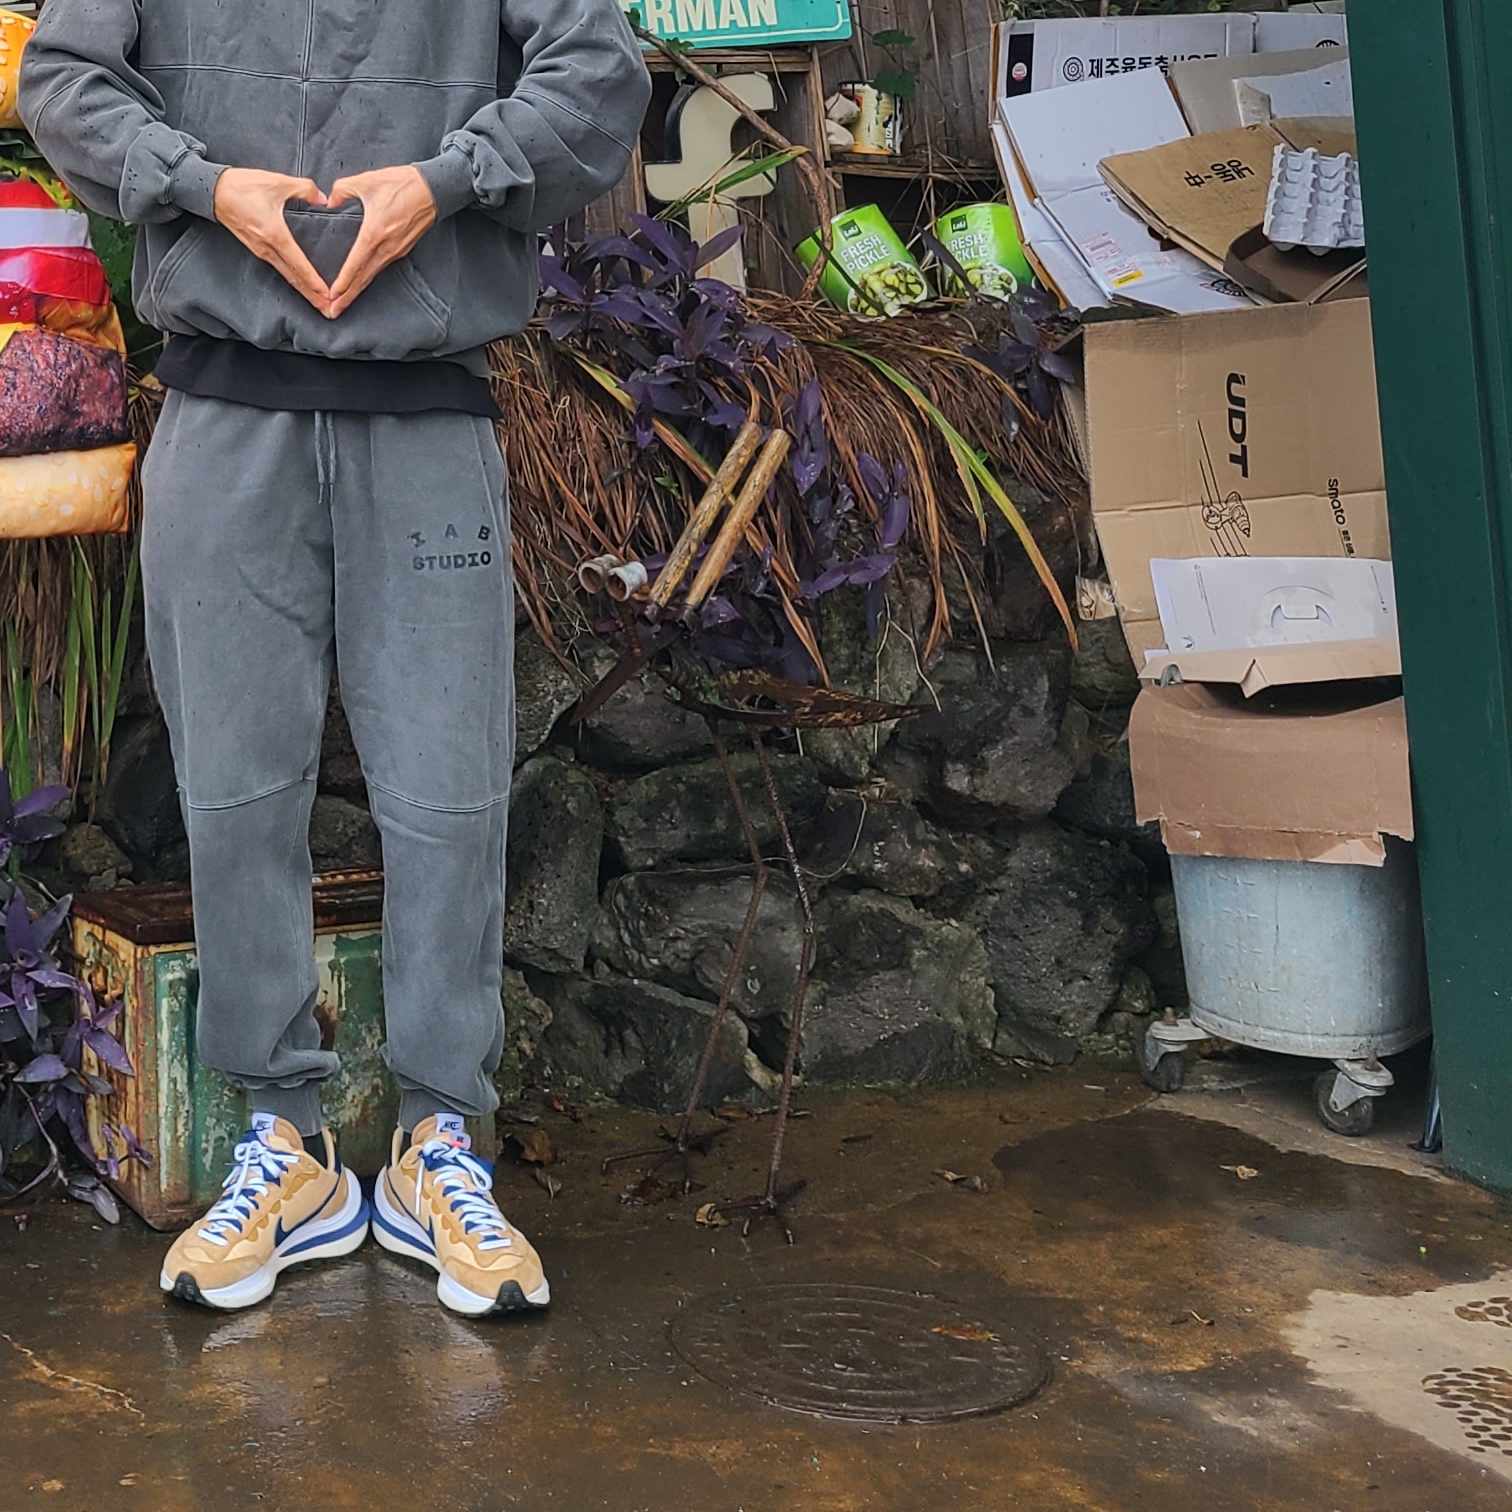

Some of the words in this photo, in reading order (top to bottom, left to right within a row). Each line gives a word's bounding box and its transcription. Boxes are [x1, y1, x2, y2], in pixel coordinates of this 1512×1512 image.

[841, 234, 882, 262] FRESH
[846, 245, 891, 275] PICKLE
[952, 245, 988, 262] CKLE
[1226, 372, 1249, 478] UDT
[1328, 478, 1346, 525] smato
[412, 551, 492, 570] STUDIO
